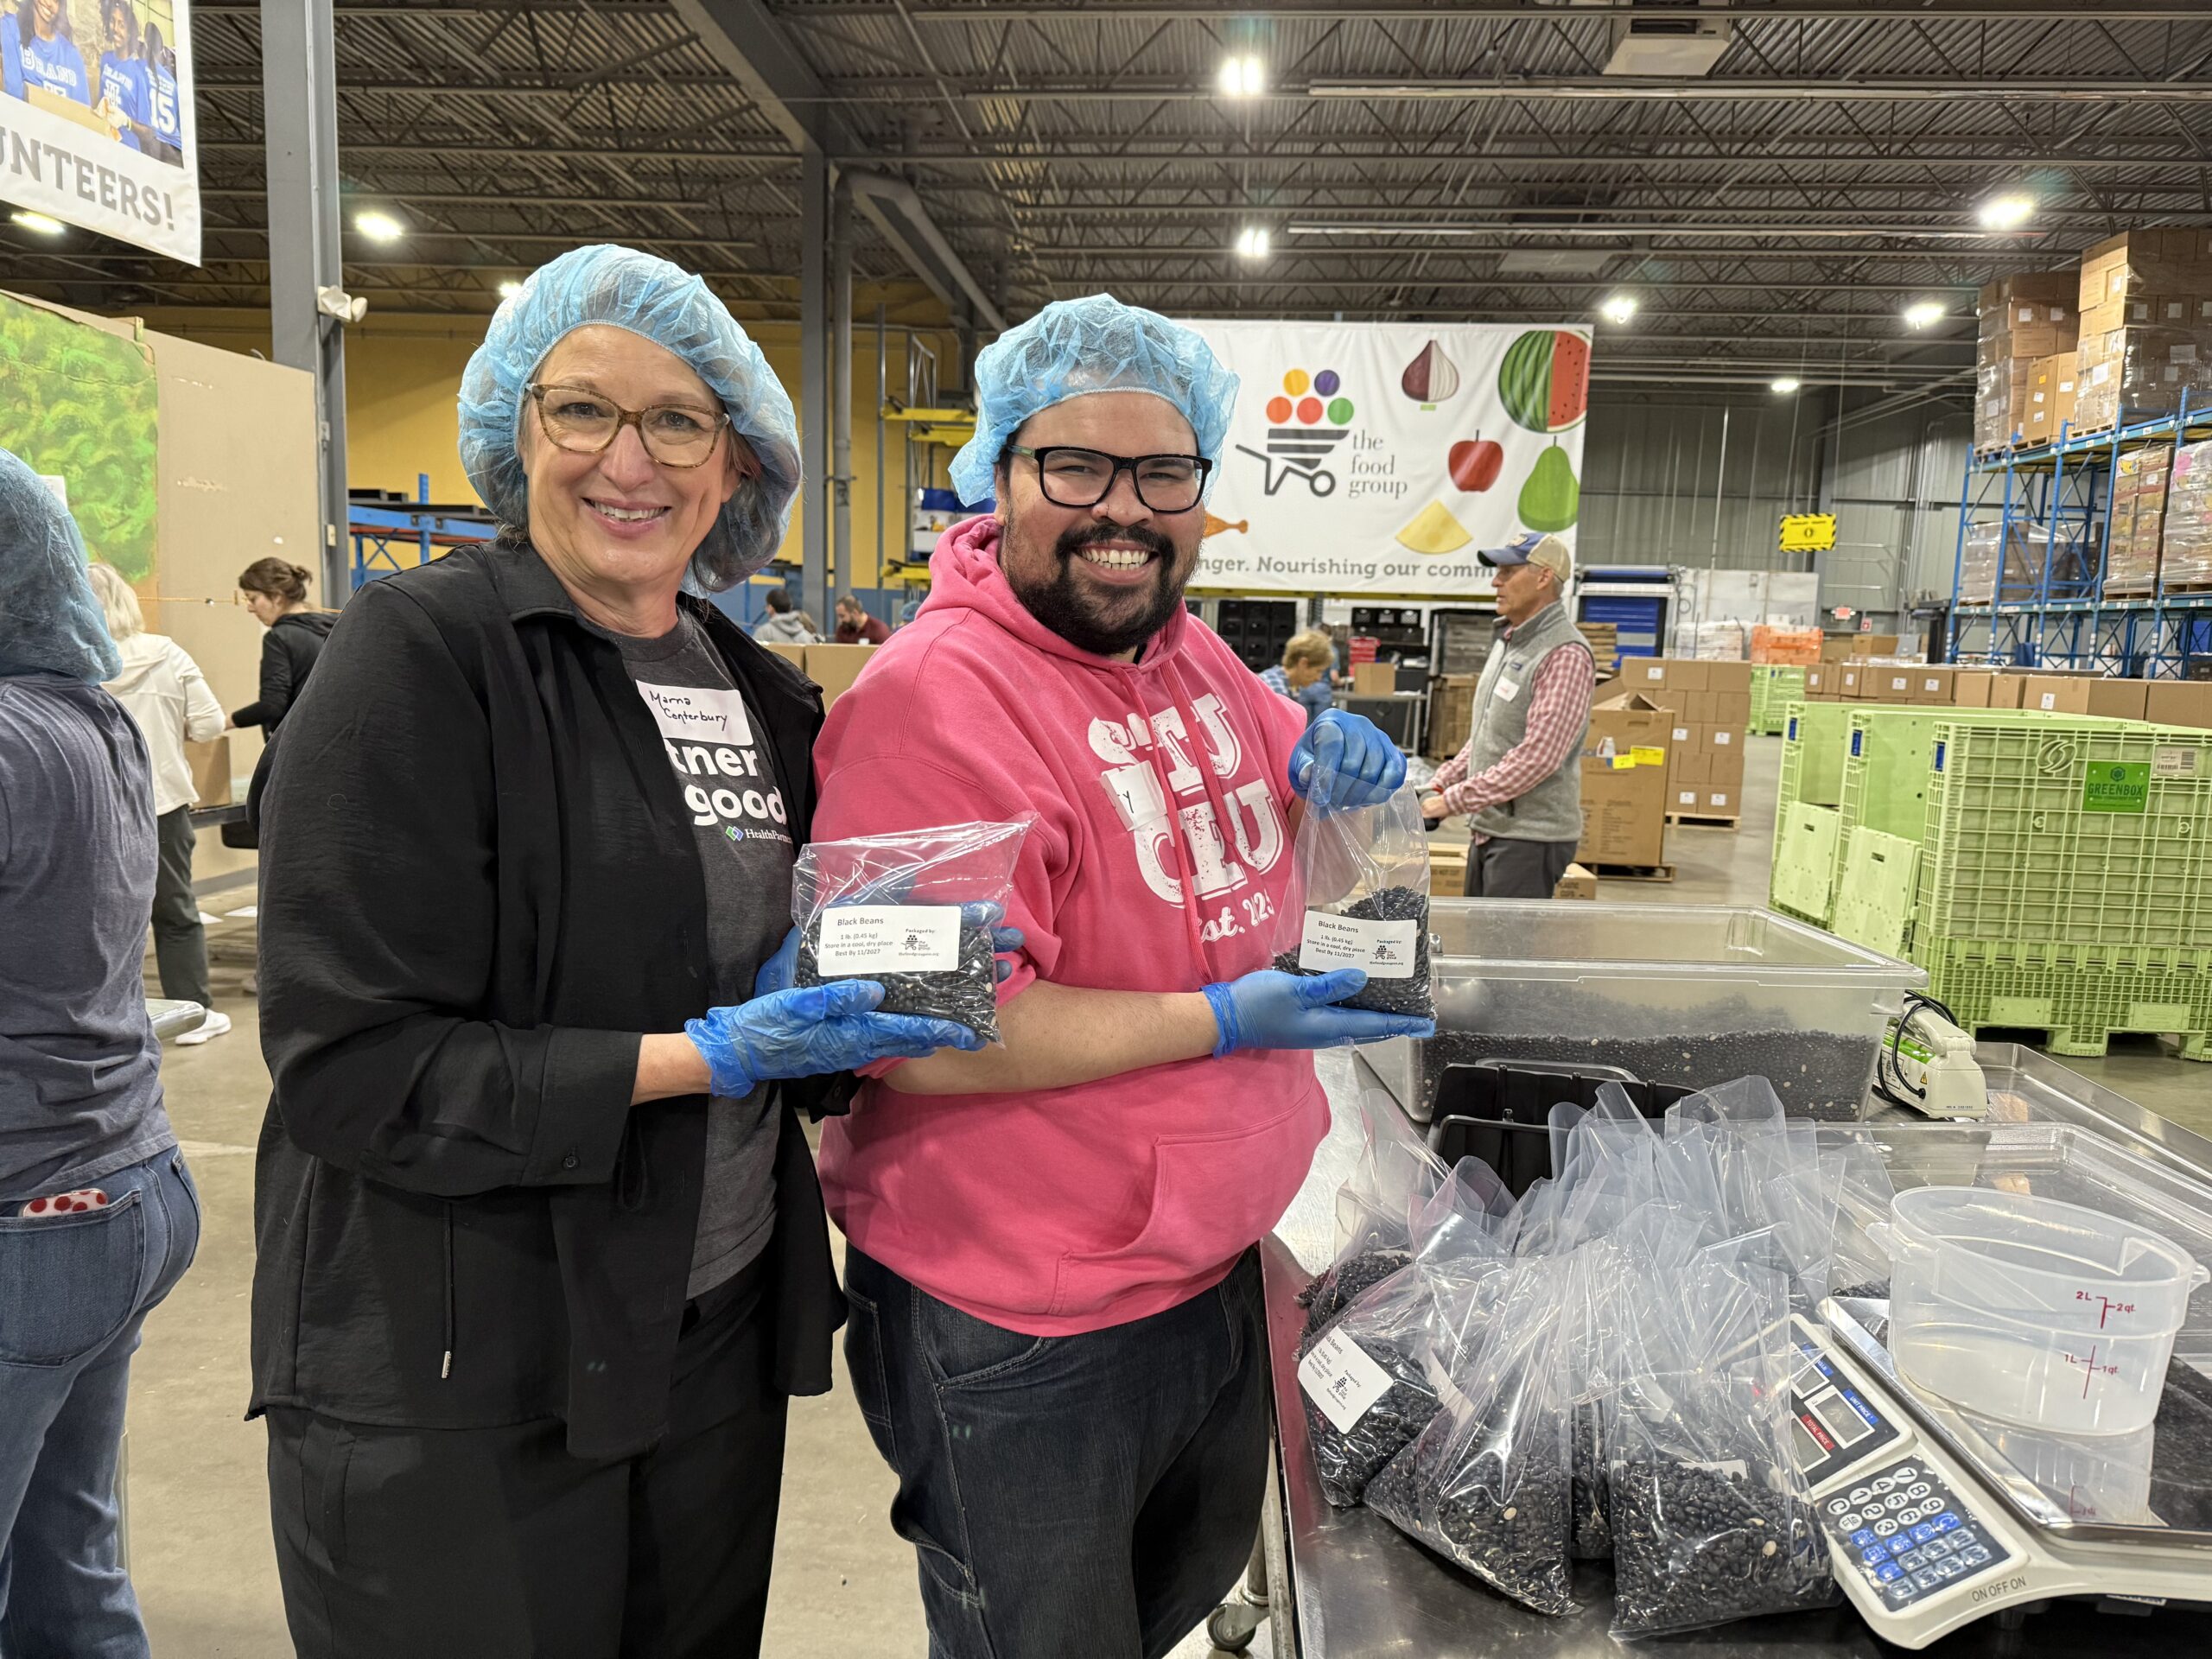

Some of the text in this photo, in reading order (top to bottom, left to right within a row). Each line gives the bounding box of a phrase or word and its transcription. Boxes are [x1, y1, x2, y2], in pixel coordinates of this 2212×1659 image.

[149, 88, 176, 134] 15
[1352, 430, 1383, 450] the
[1351, 454, 1395, 475] food
[1348, 479, 1408, 500] group
[1256, 556, 1376, 579] Nourishing
[1383, 564, 1421, 577] our
[2088, 783, 2144, 796] GREENBOX
[684, 784, 787, 826] good
[837, 918, 857, 926] Black
[1198, 906, 1246, 944] st.
[1318, 921, 1359, 933] Black Beans
[1849, 1395, 1870, 1418] UNIT PRICE
[1805, 1419, 1830, 1445] TOTAL PRICE
[1897, 1469, 1915, 1478] 7
[1876, 1482, 1892, 1491] 4
[1910, 1485, 1927, 1496] 8
[1854, 1491, 1868, 1501] 1
[1887, 1495, 1905, 1505] 5
[1864, 1505, 1882, 1516] 2
[1924, 1500, 1941, 1511] 9
[1901, 1511, 1918, 1521] 6
[1877, 1521, 1895, 1532] 3
[1972, 1576, 2026, 1602] ON OFF ON
